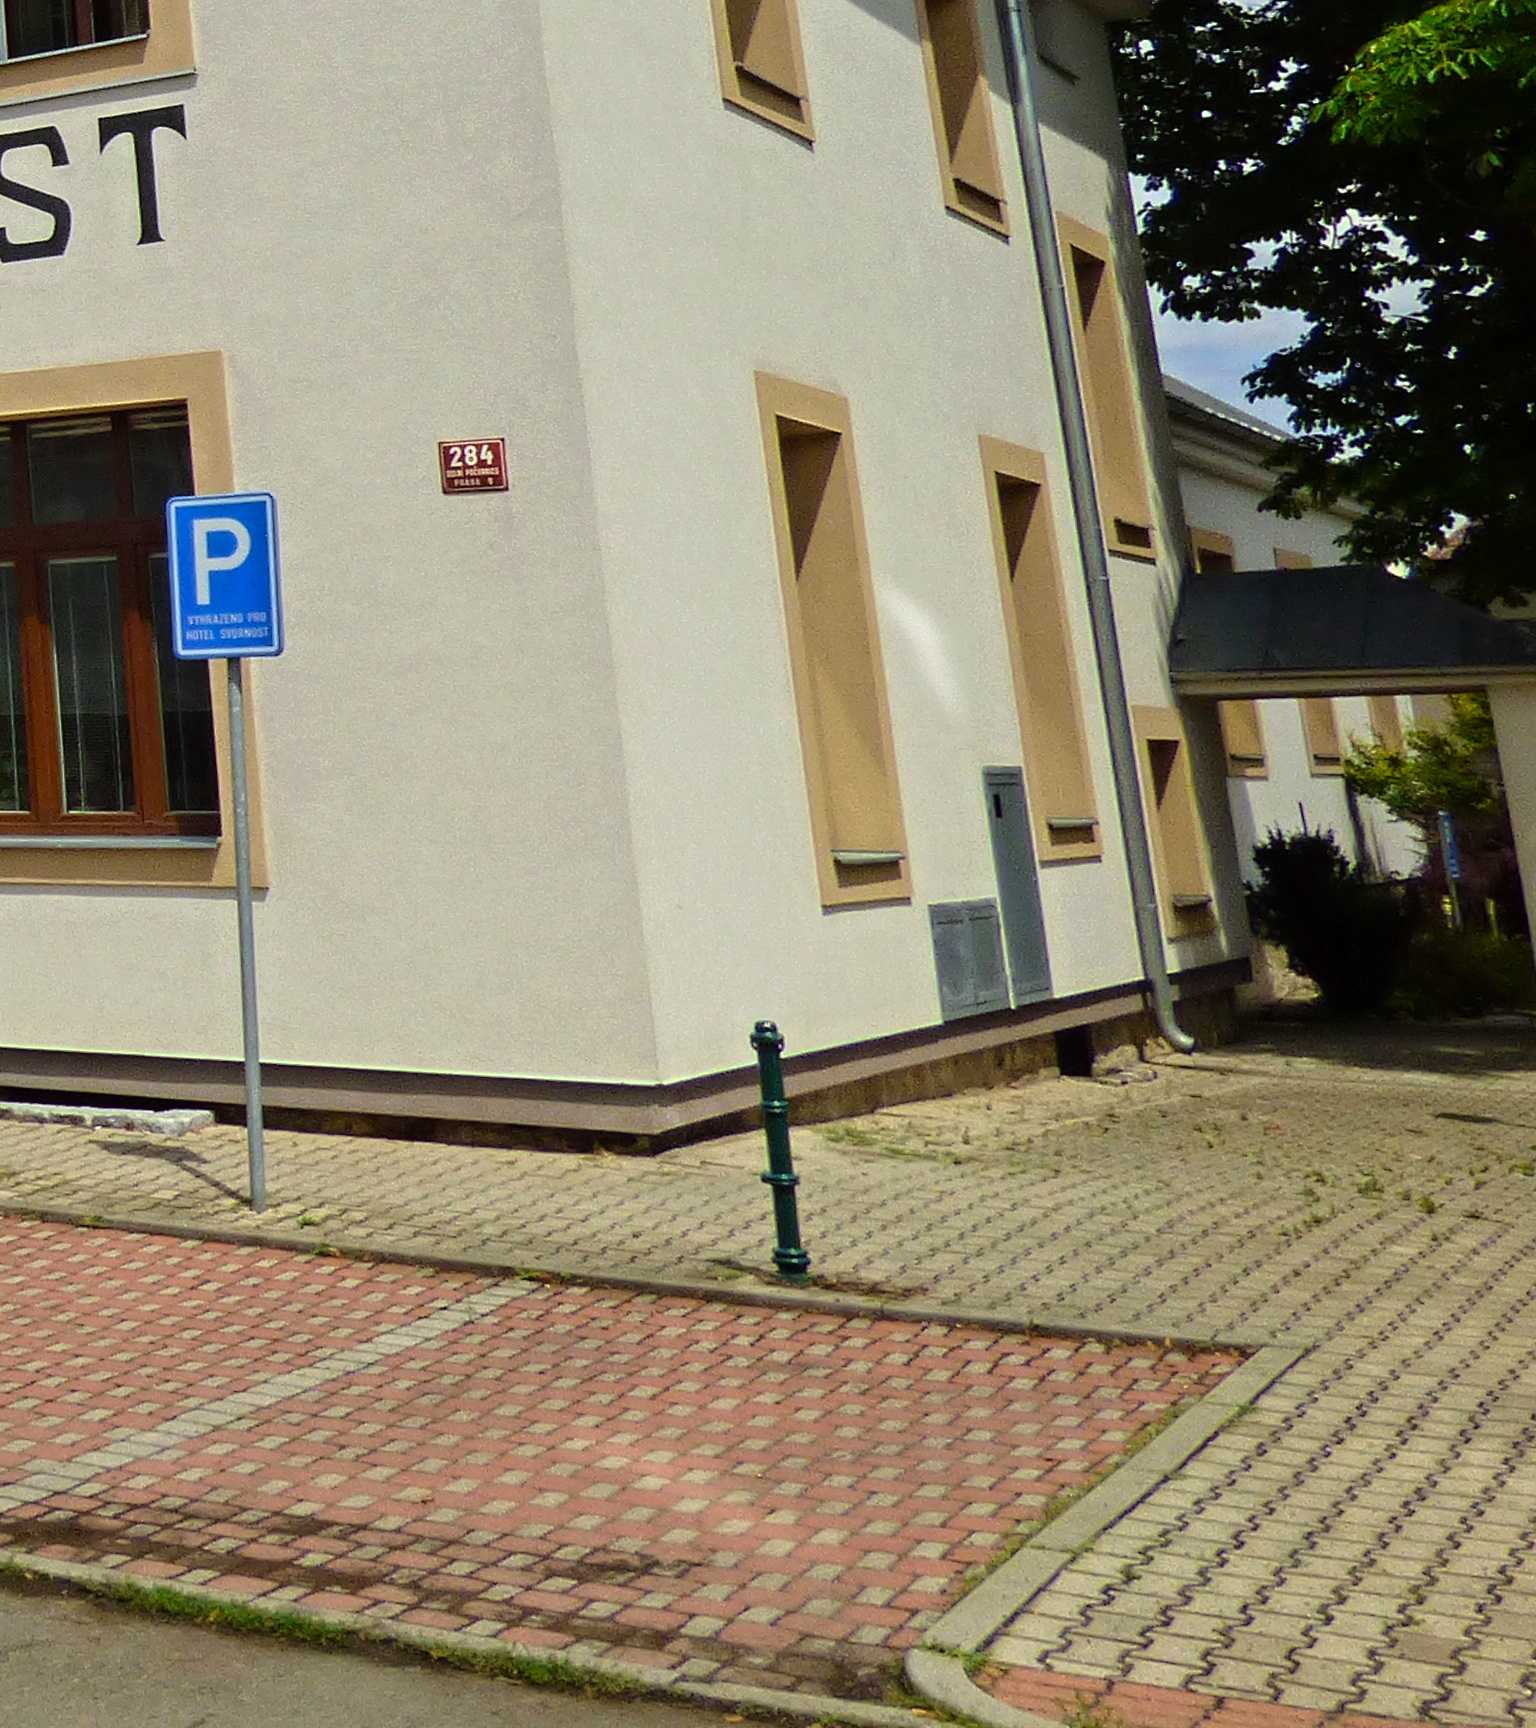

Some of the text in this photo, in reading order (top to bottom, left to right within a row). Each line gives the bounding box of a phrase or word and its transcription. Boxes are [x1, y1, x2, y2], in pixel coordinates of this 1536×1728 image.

[449, 444, 494, 467] 284
[192, 517, 252, 605] P
[188, 611, 267, 625] VYHRAZENO PRO
[186, 626, 269, 641] HOTEL SVORNOST
